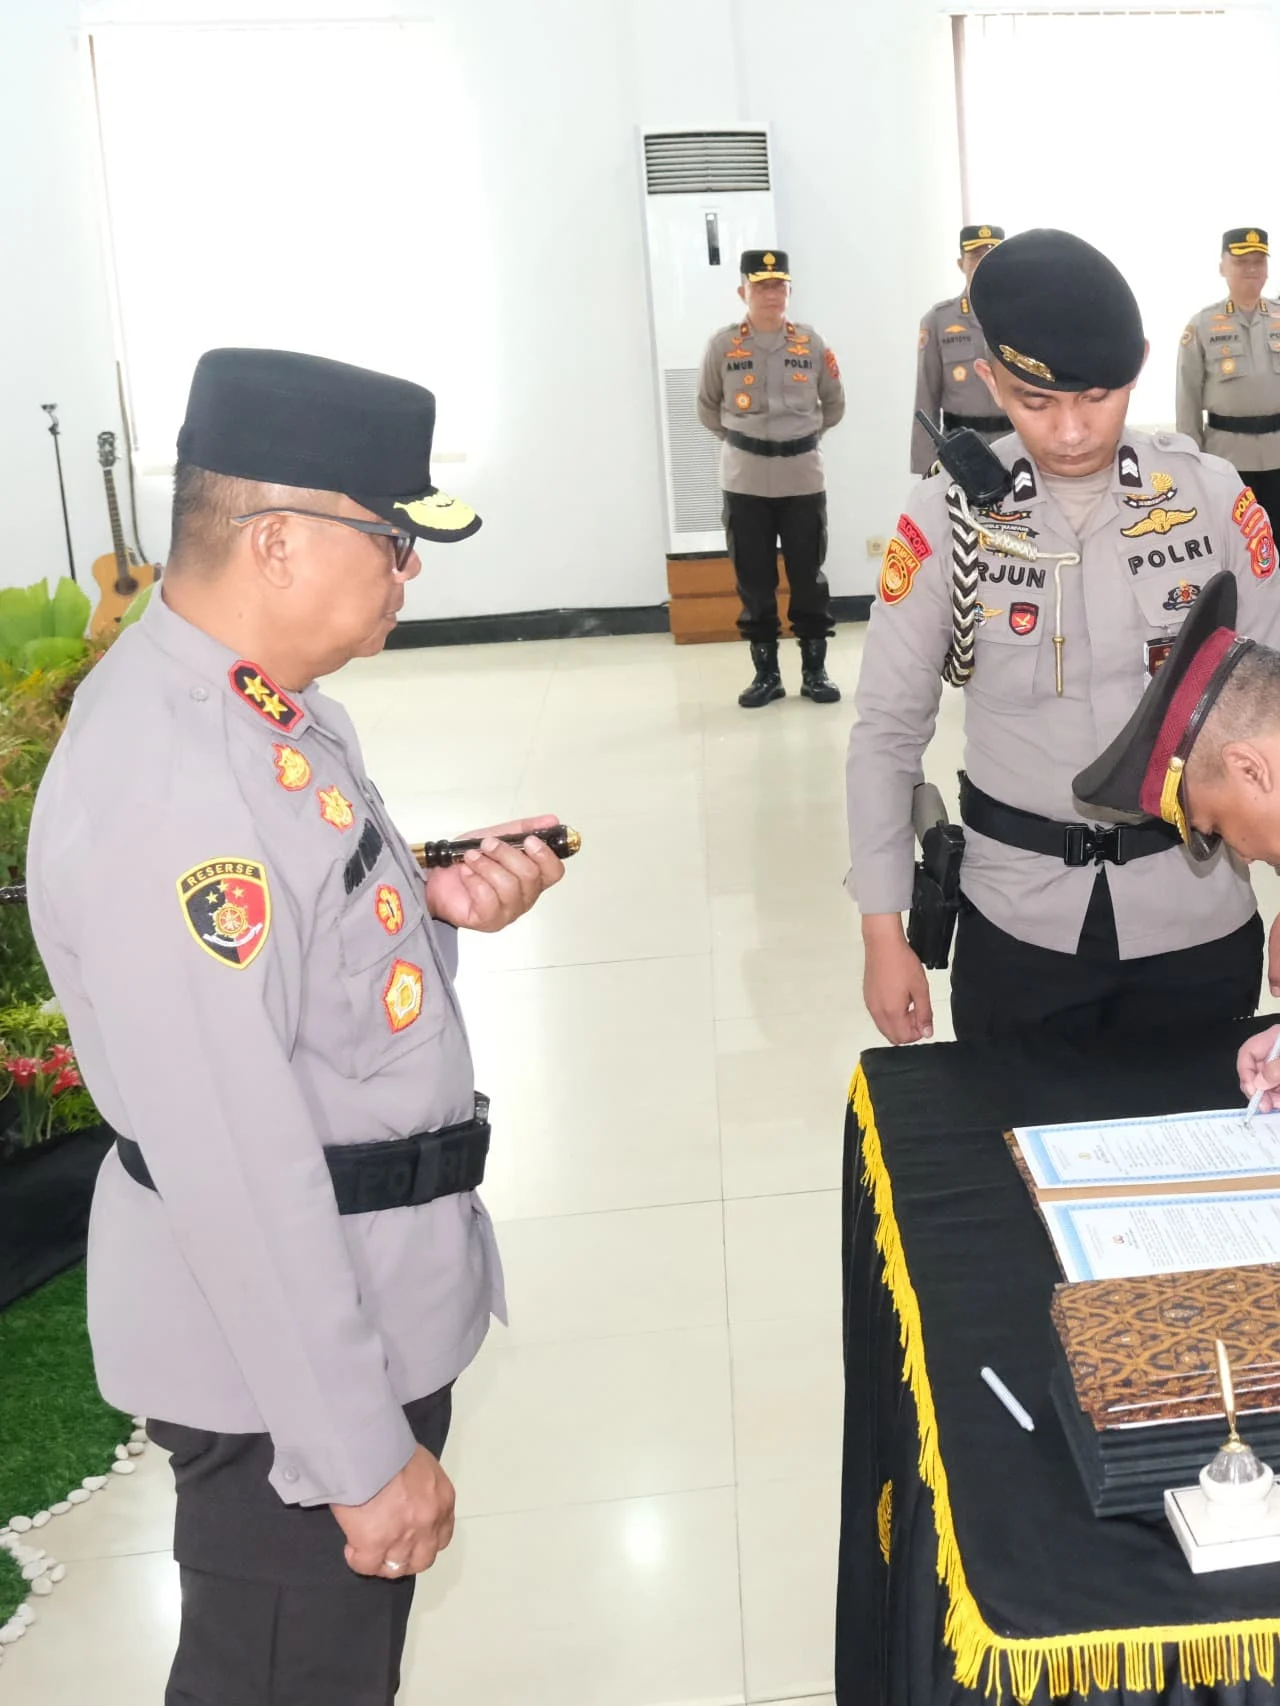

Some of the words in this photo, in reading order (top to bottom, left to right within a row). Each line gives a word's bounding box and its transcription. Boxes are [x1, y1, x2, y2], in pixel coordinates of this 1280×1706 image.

[1127, 535, 1213, 576] POLRI
[977, 561, 1046, 589] RJUN
[187, 863, 255, 887] RESERSE
